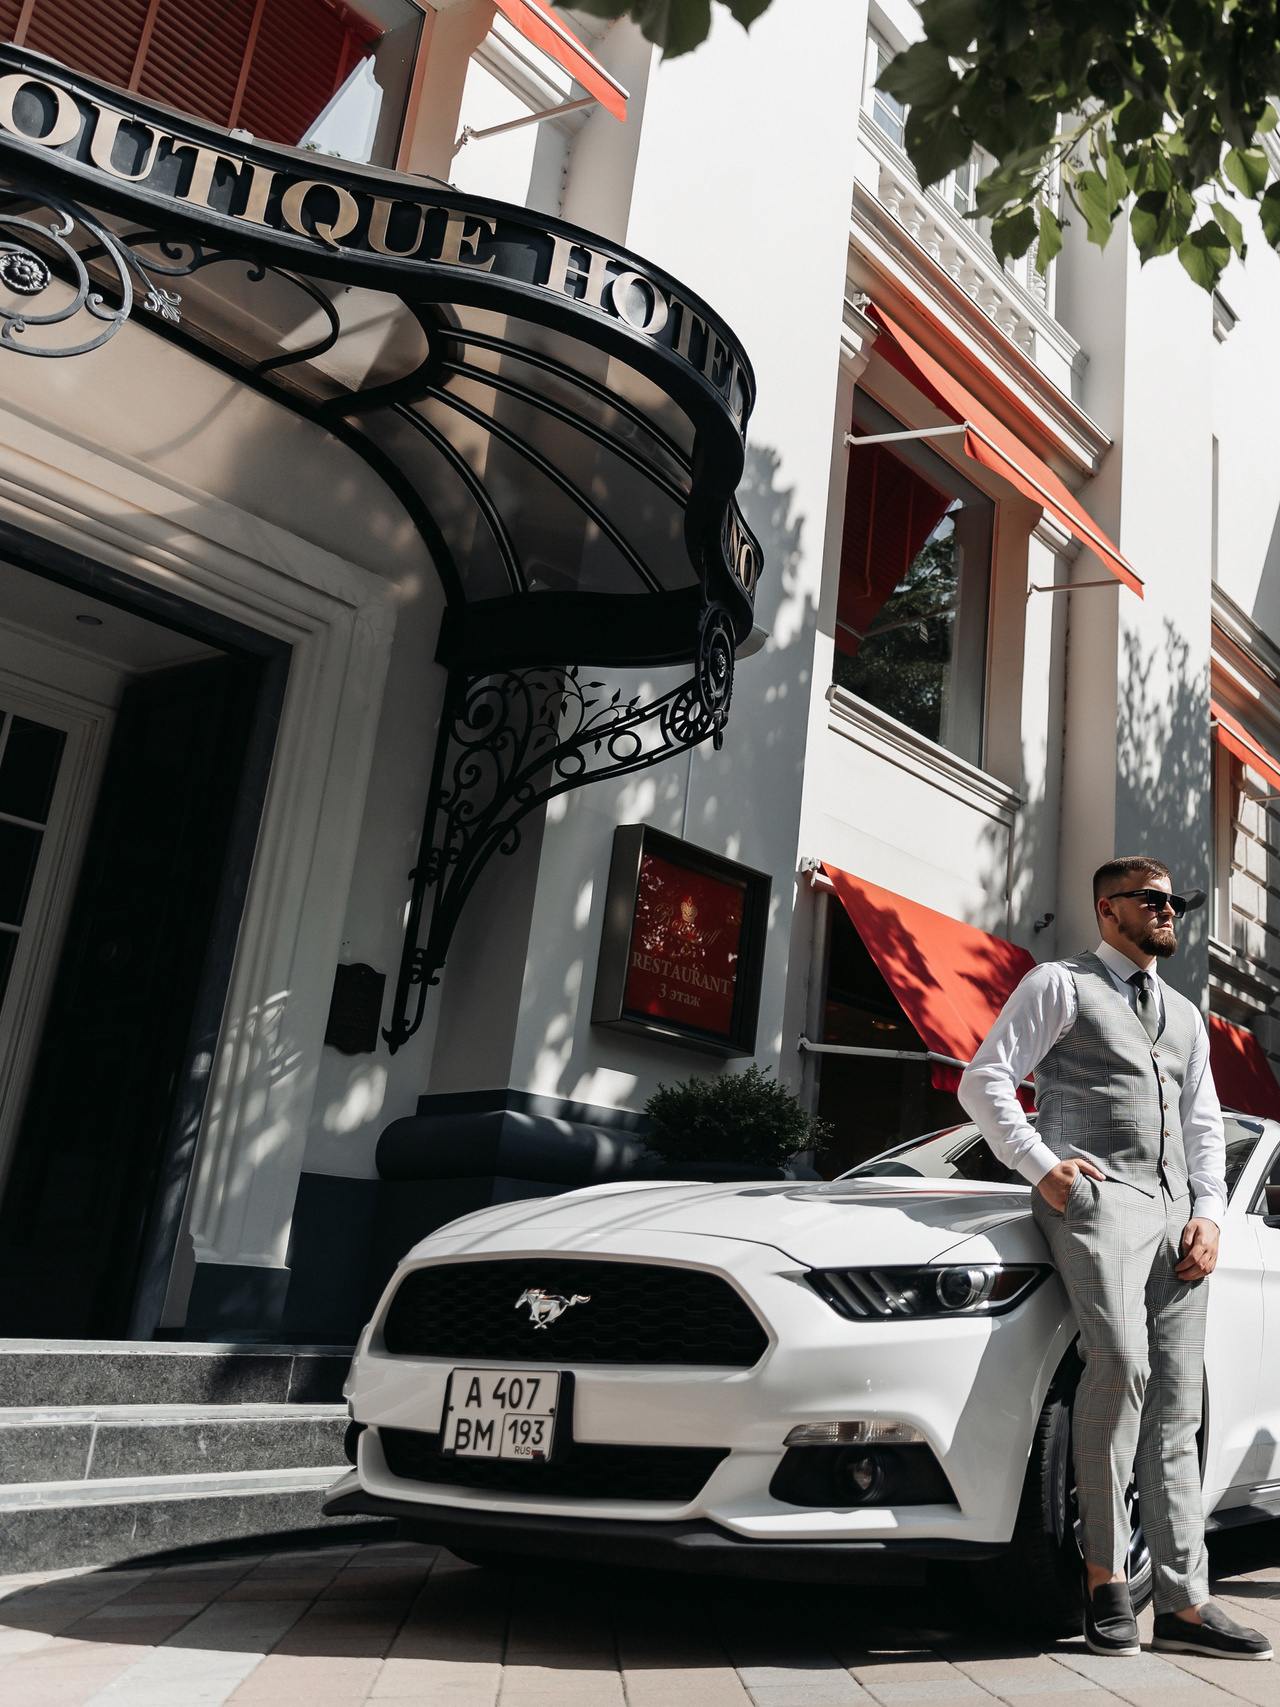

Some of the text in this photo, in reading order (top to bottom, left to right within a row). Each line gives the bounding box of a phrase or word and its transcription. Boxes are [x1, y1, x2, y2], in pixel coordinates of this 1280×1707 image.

[539, 233, 744, 432] HOTEL
[632, 951, 731, 995] RESTAURANT
[658, 983, 701, 1008] 3 этаж
[492, 1377, 541, 1410] 407
[508, 1419, 545, 1445] 193
[514, 1445, 531, 1455] RUS
